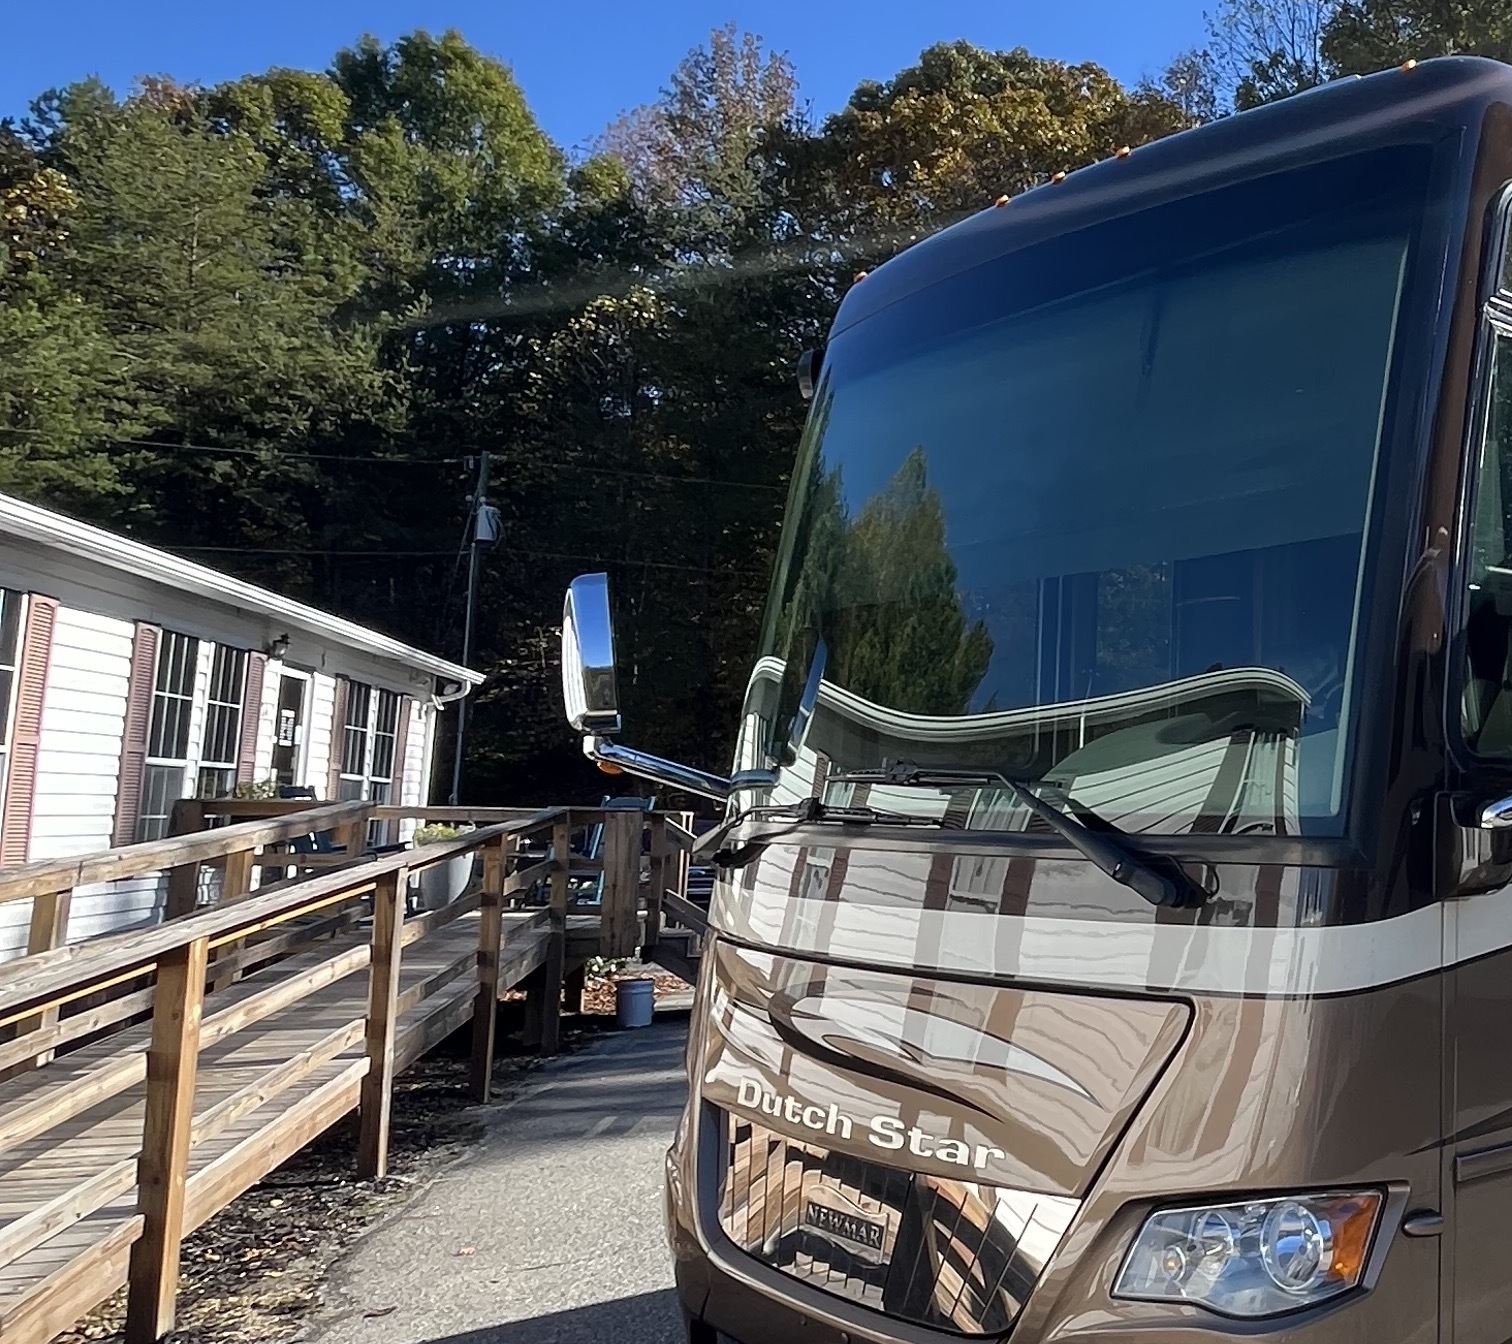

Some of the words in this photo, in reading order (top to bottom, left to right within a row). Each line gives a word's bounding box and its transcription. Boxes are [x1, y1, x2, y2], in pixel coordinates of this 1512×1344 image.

[736, 1075, 852, 1140] Dutch
[868, 1113, 1006, 1170] Star
[806, 1204, 881, 1249] NEWMAR
